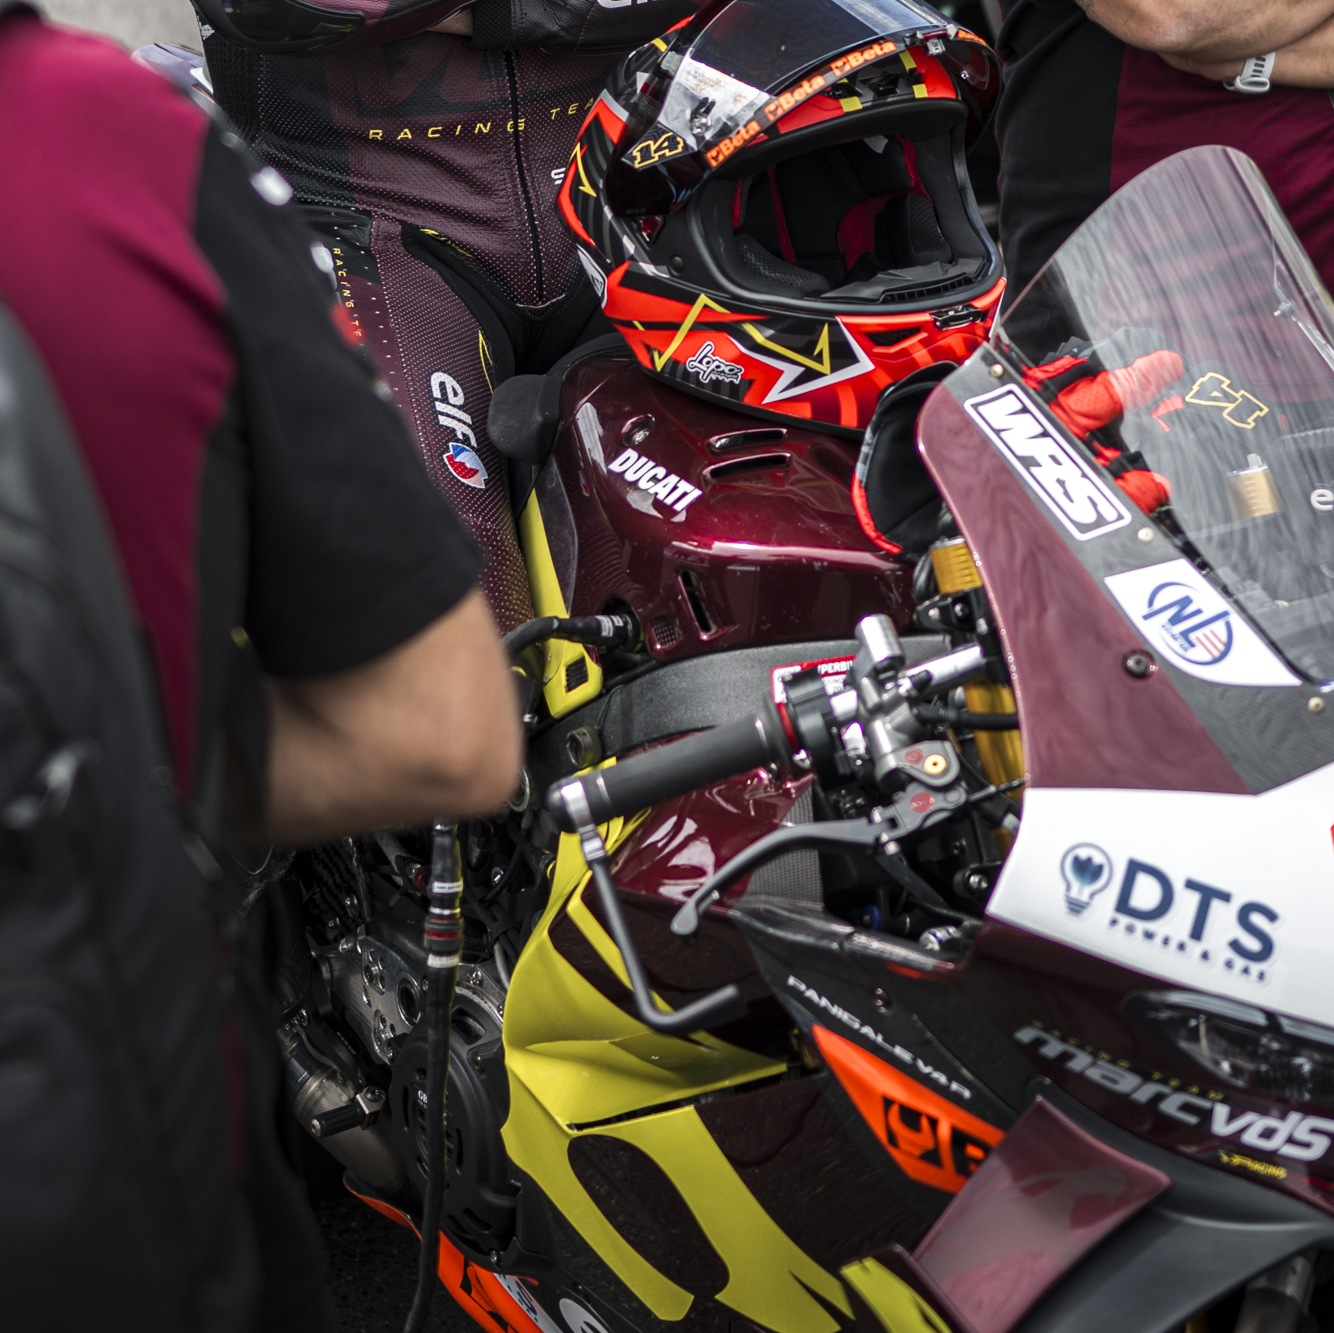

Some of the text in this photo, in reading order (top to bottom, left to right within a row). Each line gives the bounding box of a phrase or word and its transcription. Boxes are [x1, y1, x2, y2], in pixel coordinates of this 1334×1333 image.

[845, 40, 897, 70] Beta
[369, 98, 594, 141] RACING TEA
[777, 74, 827, 111] Beta
[631, 131, 685, 169] 14
[718, 119, 762, 159] Beta
[333, 247, 355, 308] RACING
[430, 370, 478, 448] elf
[607, 447, 703, 512] DUCATI
[976, 393, 1119, 524] WRS
[1113, 857, 1280, 964] DTS
[1108, 916, 1267, 982] POWER & GAS
[786, 974, 914, 1065] PANIGALE
